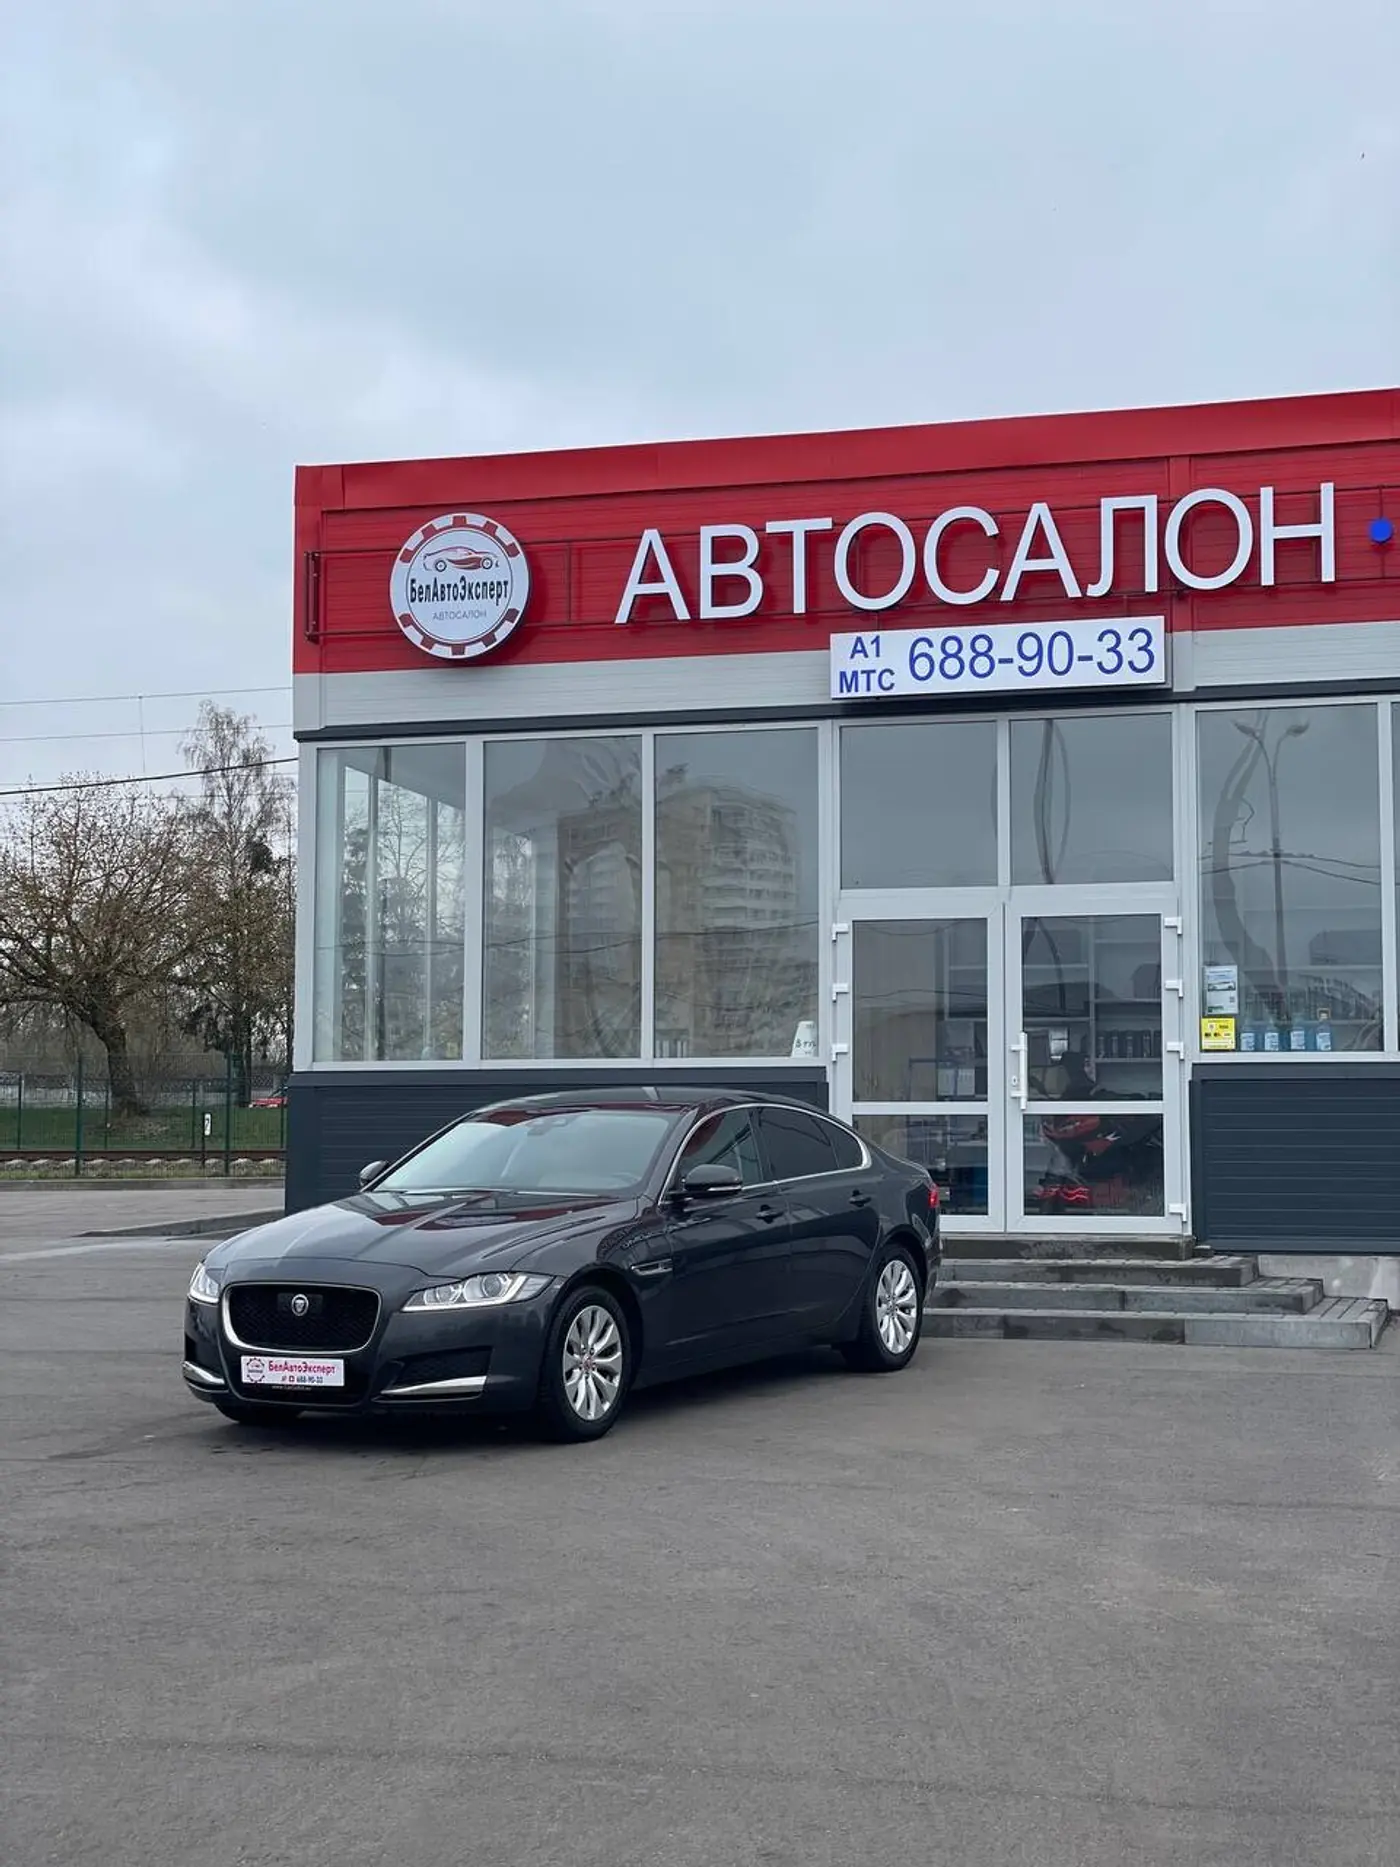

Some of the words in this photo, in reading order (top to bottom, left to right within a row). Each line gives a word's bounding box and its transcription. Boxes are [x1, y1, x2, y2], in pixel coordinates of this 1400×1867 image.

[614, 482, 1336, 624] АВТОСАЛОН
[409, 575, 509, 606] БелАвтоЭксперт
[432, 609, 488, 621] АВТОСАЛОН
[850, 635, 881, 659] A1
[908, 627, 1155, 682] 688-90-33
[839, 668, 896, 694] МТС
[268, 1360, 336, 1376] БелАвтоЭксперт
